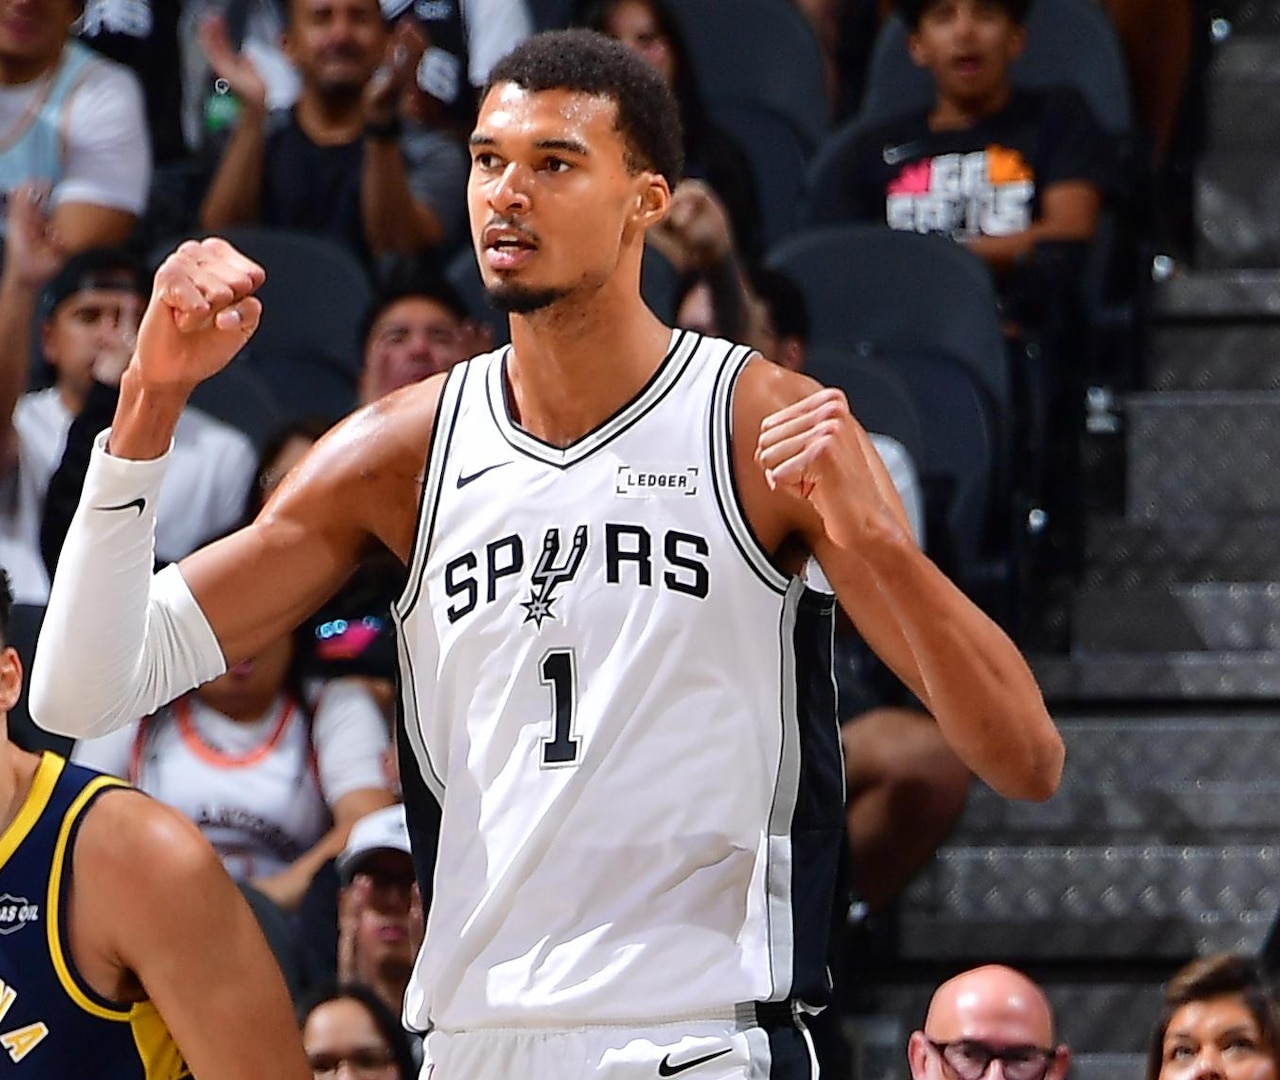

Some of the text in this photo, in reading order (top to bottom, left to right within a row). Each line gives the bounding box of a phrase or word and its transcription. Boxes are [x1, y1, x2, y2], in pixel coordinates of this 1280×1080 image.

[626, 474, 687, 489] LEDGER
[444, 523, 710, 631] SPURS
[537, 647, 583, 770] 1
[18, 904, 40, 922] OIL
